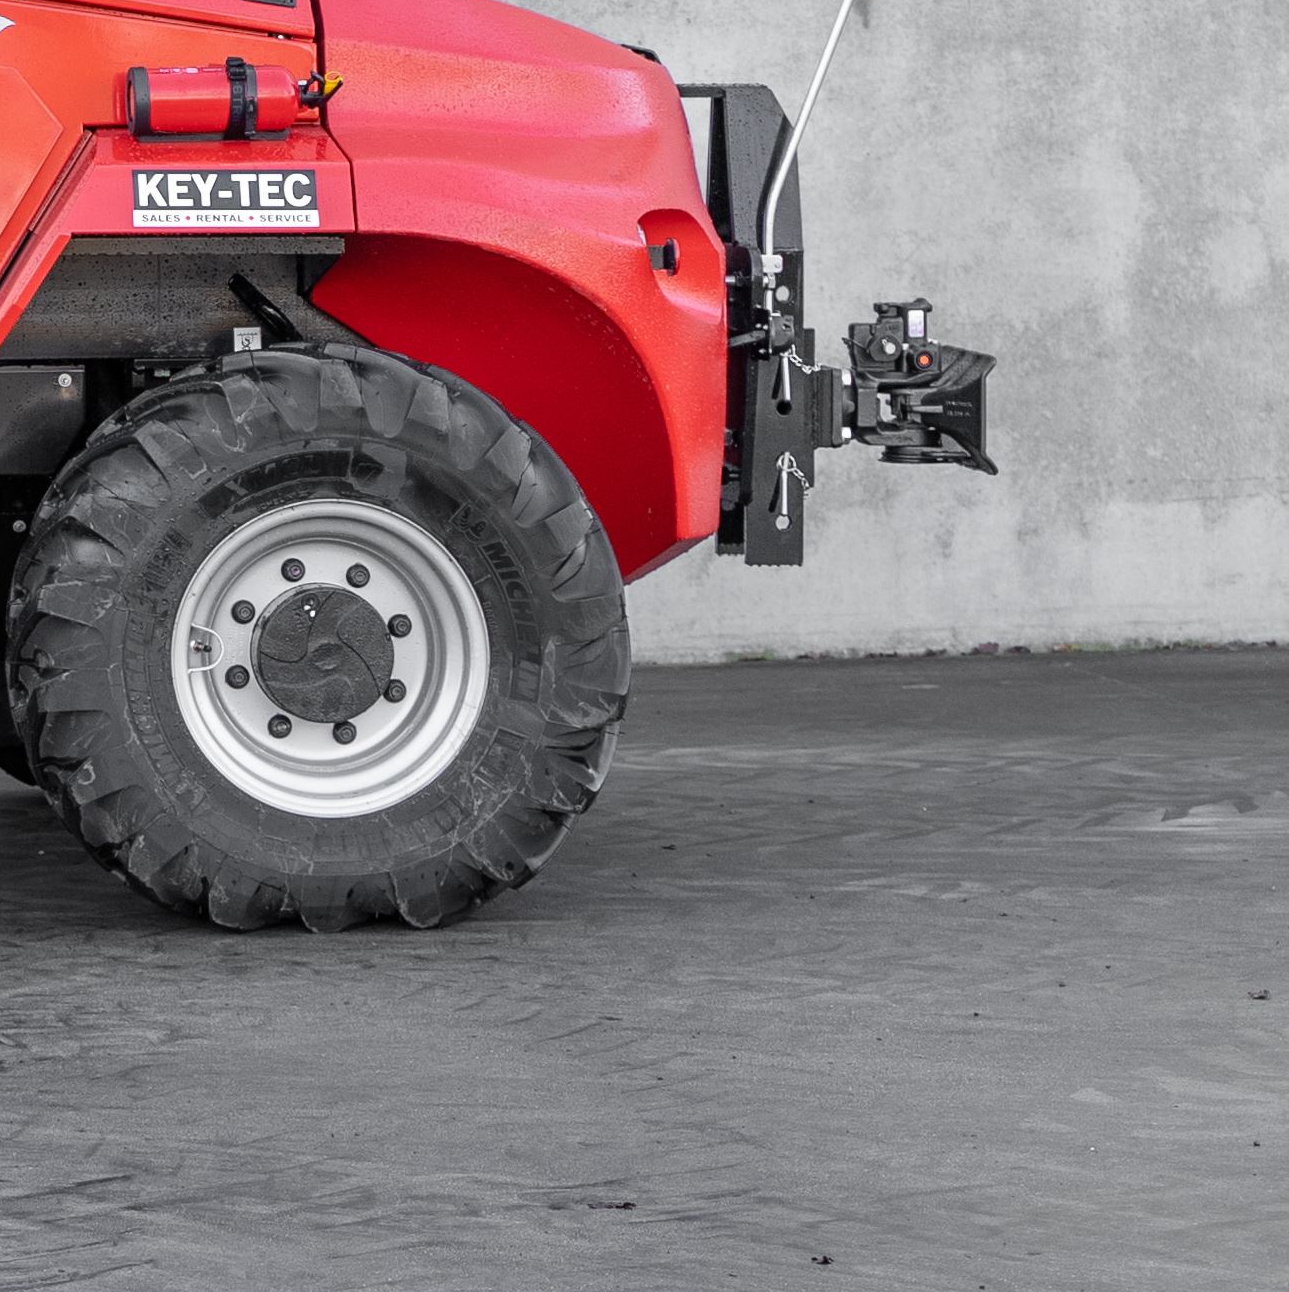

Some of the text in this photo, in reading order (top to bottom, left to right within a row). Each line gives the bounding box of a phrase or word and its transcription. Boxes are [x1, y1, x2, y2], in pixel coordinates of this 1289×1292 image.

[137, 173, 312, 208] KEY-TEC
[142, 214, 312, 222] SALES RENTAL SERVICE
